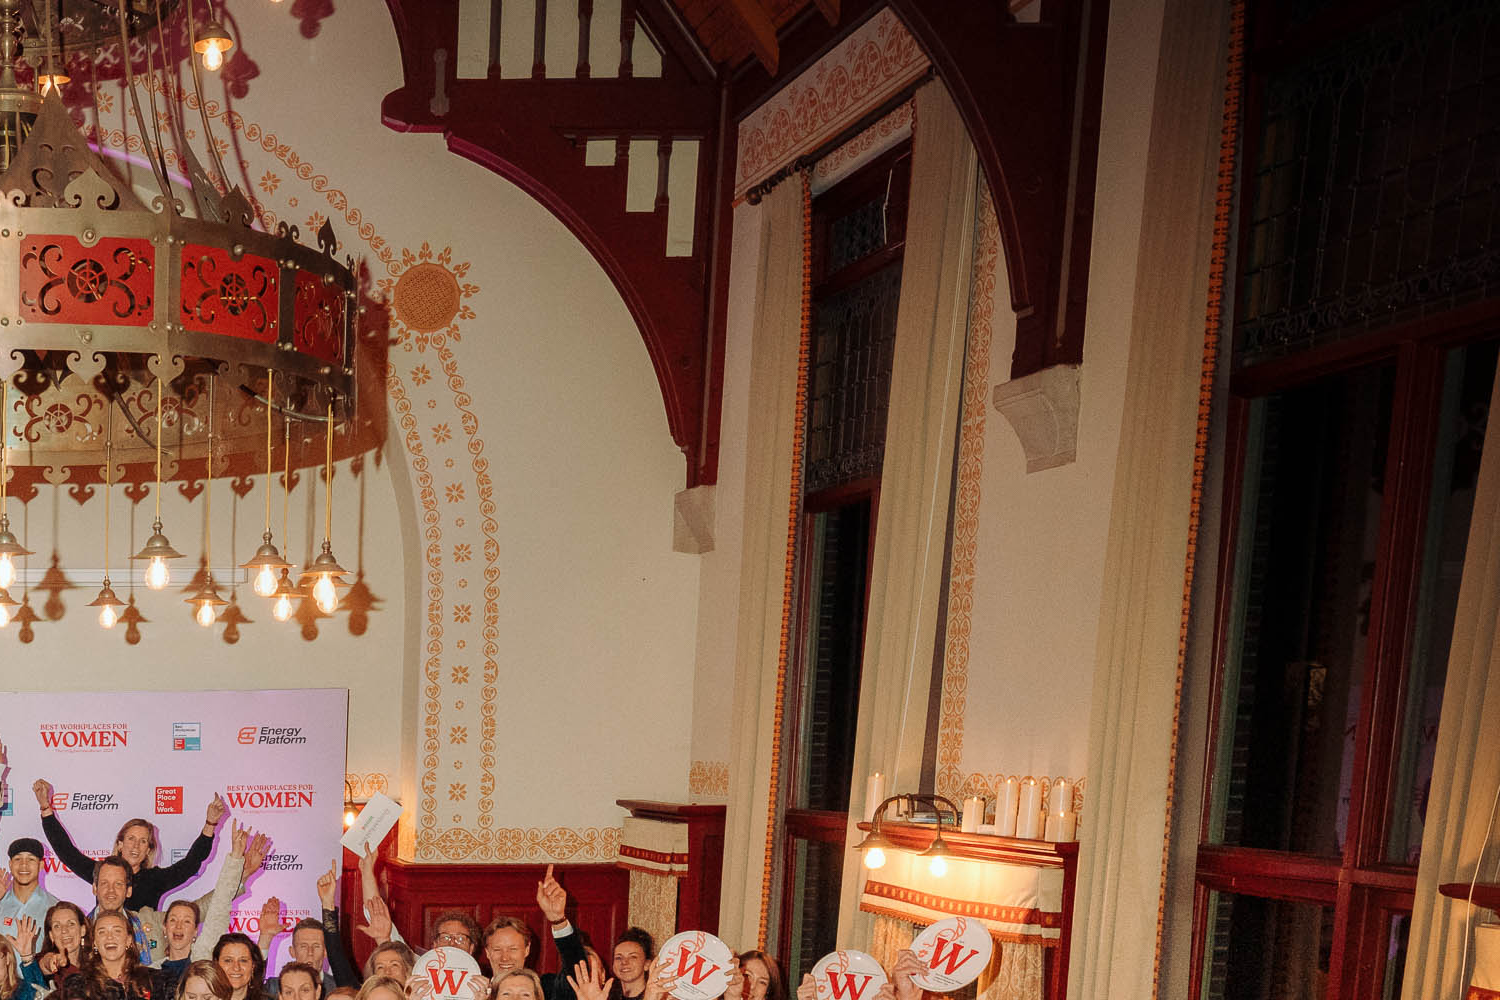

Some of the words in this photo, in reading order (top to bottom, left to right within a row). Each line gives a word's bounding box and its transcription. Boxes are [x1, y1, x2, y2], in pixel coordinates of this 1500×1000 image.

[40, 731, 128, 747] WOMEN
[258, 735, 306, 744] Platform
[260, 727, 302, 736] Energy
[72, 792, 113, 802] Energy
[226, 791, 313, 808] WOMEN
[71, 801, 119, 810] Platform
[263, 854, 299, 863] nergy
[929, 937, 979, 975] W
[677, 946, 721, 985] W
[429, 968, 469, 995] W
[827, 971, 873, 1000] W
